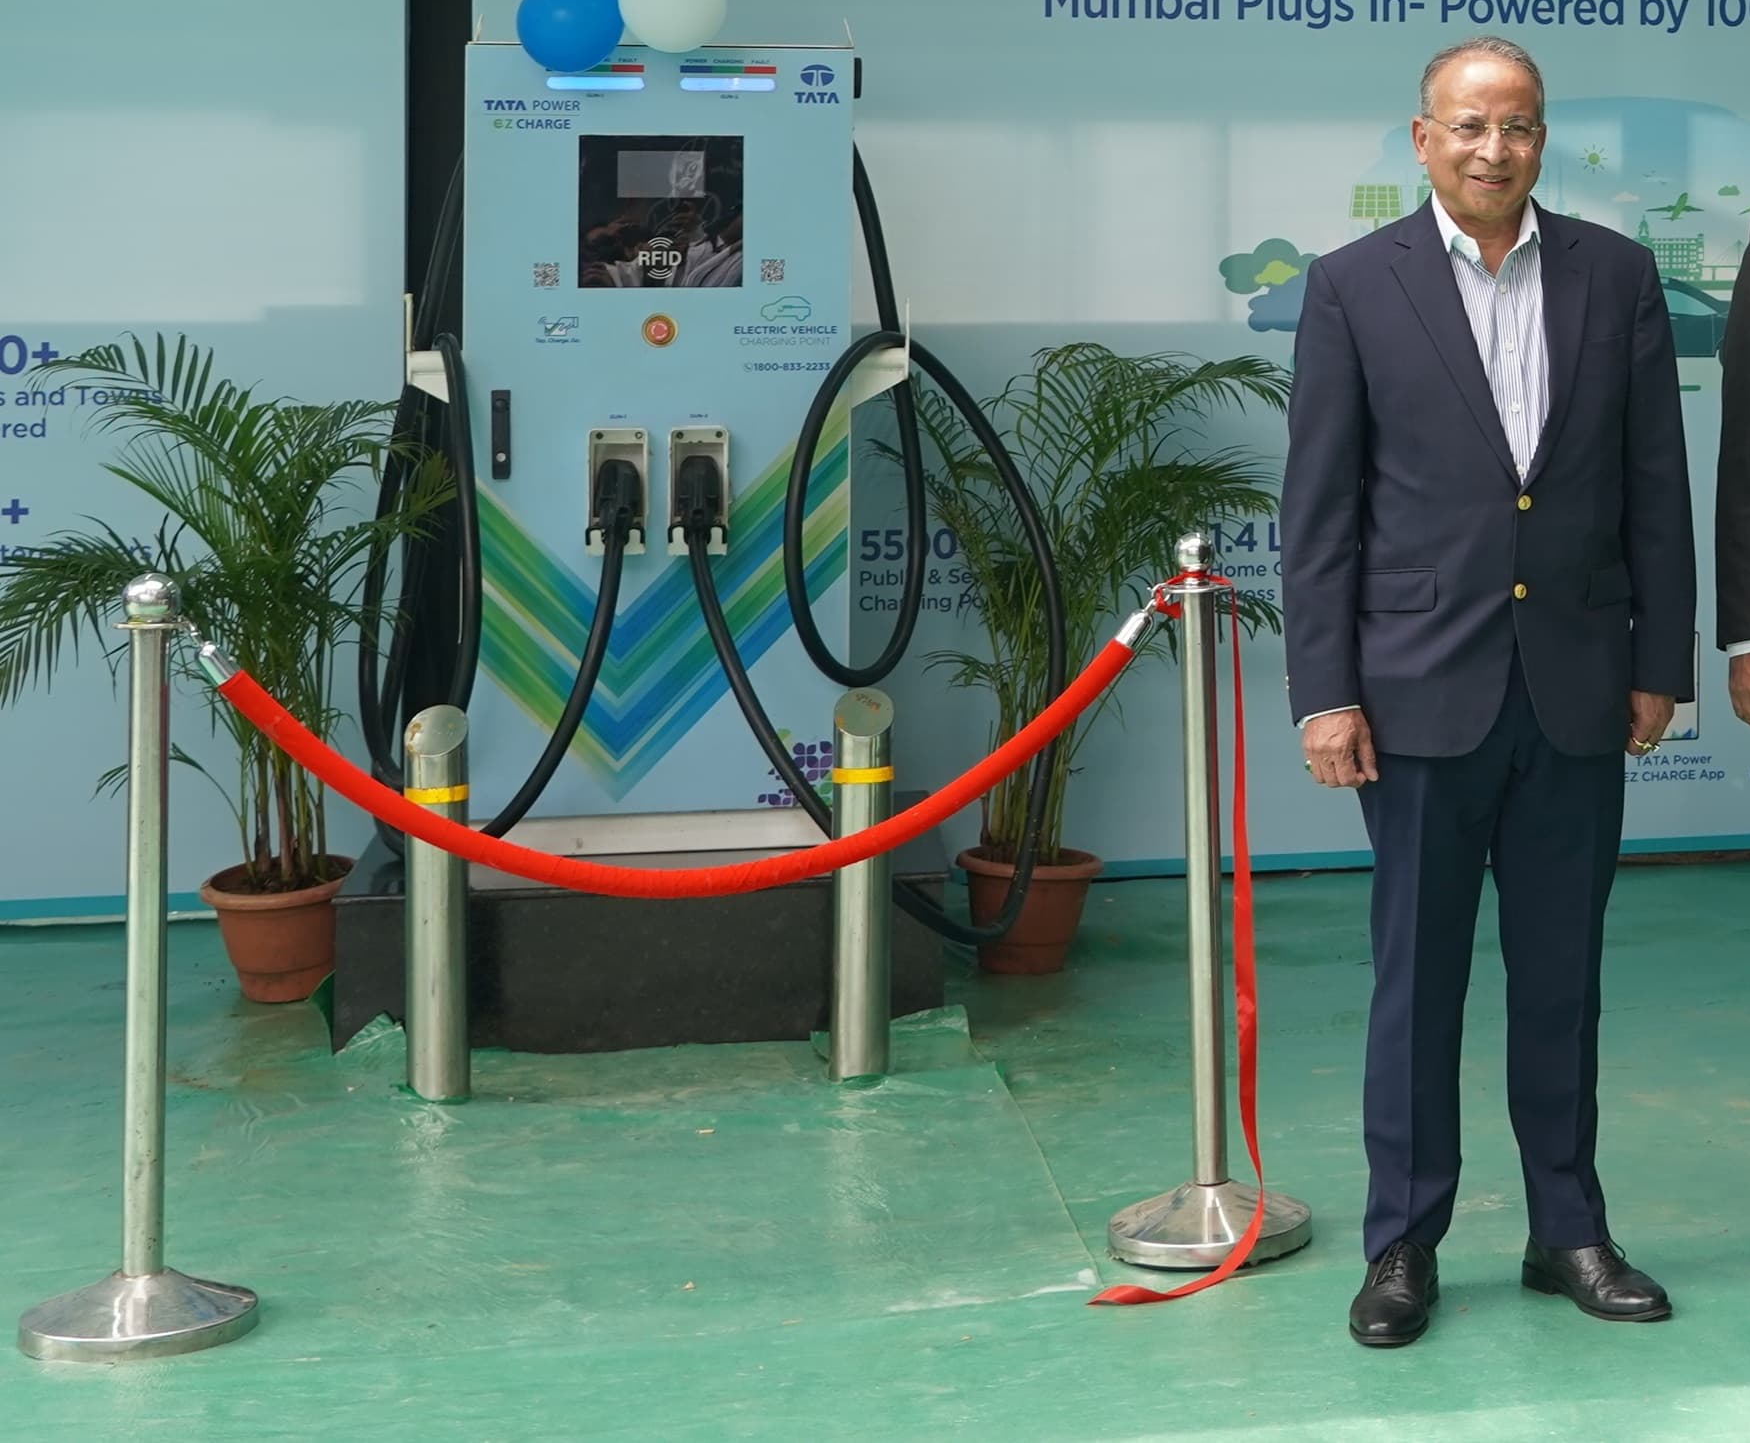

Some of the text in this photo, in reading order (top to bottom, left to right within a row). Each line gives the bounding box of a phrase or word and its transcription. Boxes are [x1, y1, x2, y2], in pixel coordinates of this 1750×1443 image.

[794, 92, 840, 105] TATA
[483, 99, 581, 112] TATA POWER
[516, 118, 572, 130] CHARGE
[637, 250, 683, 267] RFID
[733, 325, 839, 335] ELECTRIC VEHICLE
[739, 336, 831, 346] CHARGING POINT
[753, 362, 831, 372] 1800-833-2233
[15, 386, 65, 406] and
[859, 593, 952, 613] Chaing
[1635, 754, 1713, 767] TATA Power
[1641, 770, 1696, 782] CHARGE
[1699, 769, 1726, 782] App
